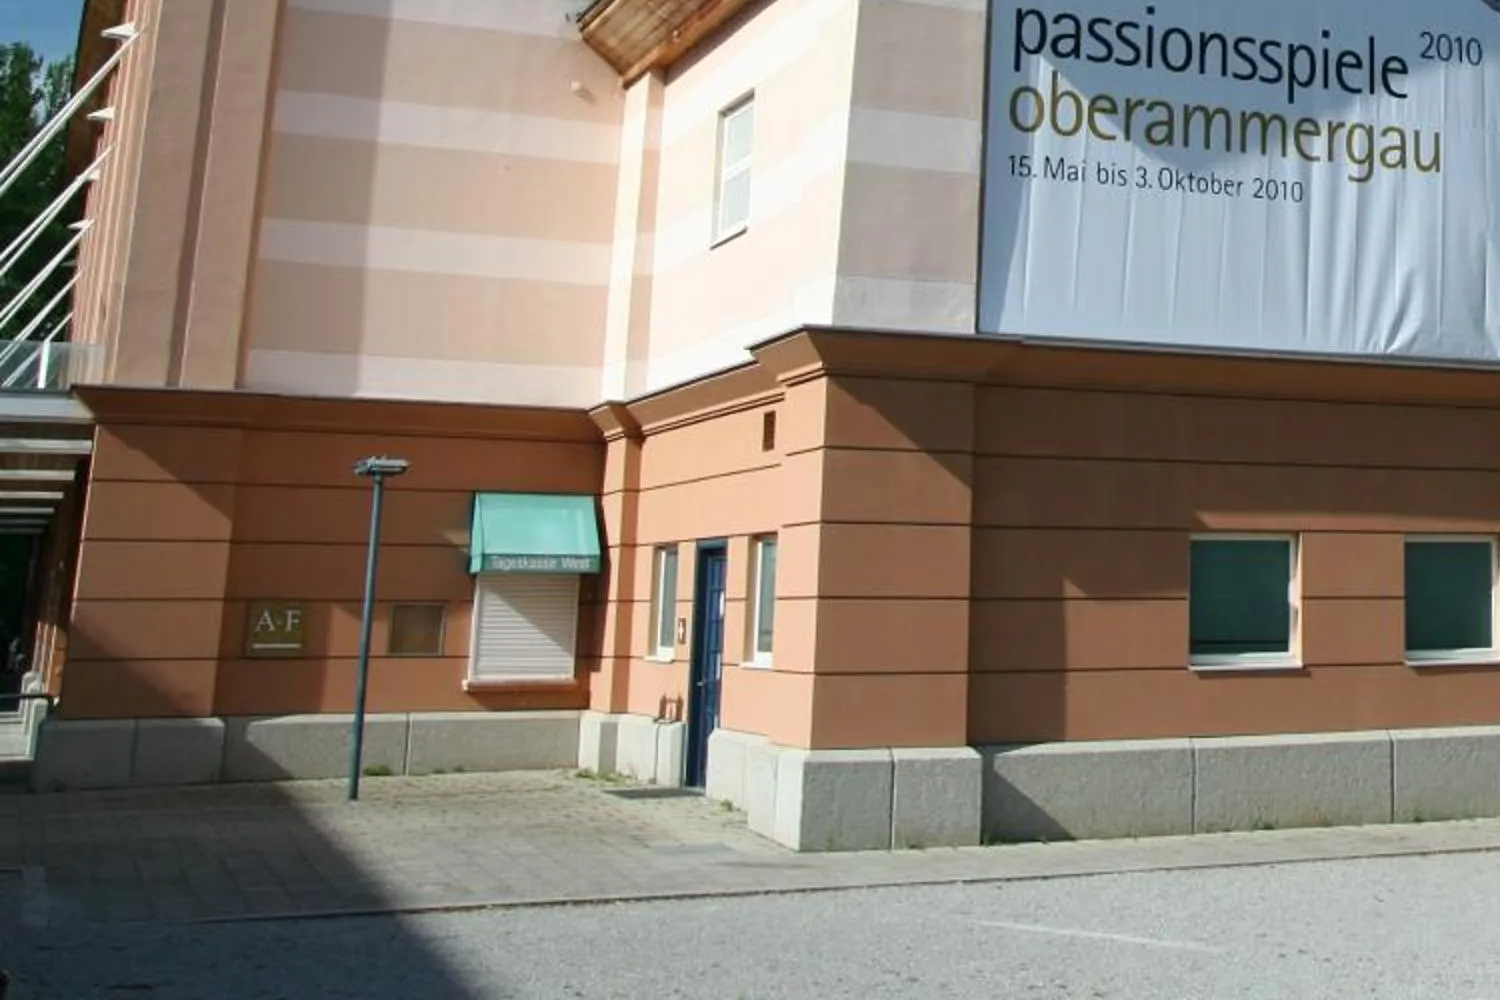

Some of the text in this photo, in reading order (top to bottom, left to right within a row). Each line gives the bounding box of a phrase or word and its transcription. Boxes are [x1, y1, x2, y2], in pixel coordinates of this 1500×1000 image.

[1013, 5, 1483, 104] passionsspiele 2010
[1009, 69, 1442, 183] oberammergau
[1007, 154, 1305, 204] 15. Mai bis 3. Oktober 2010
